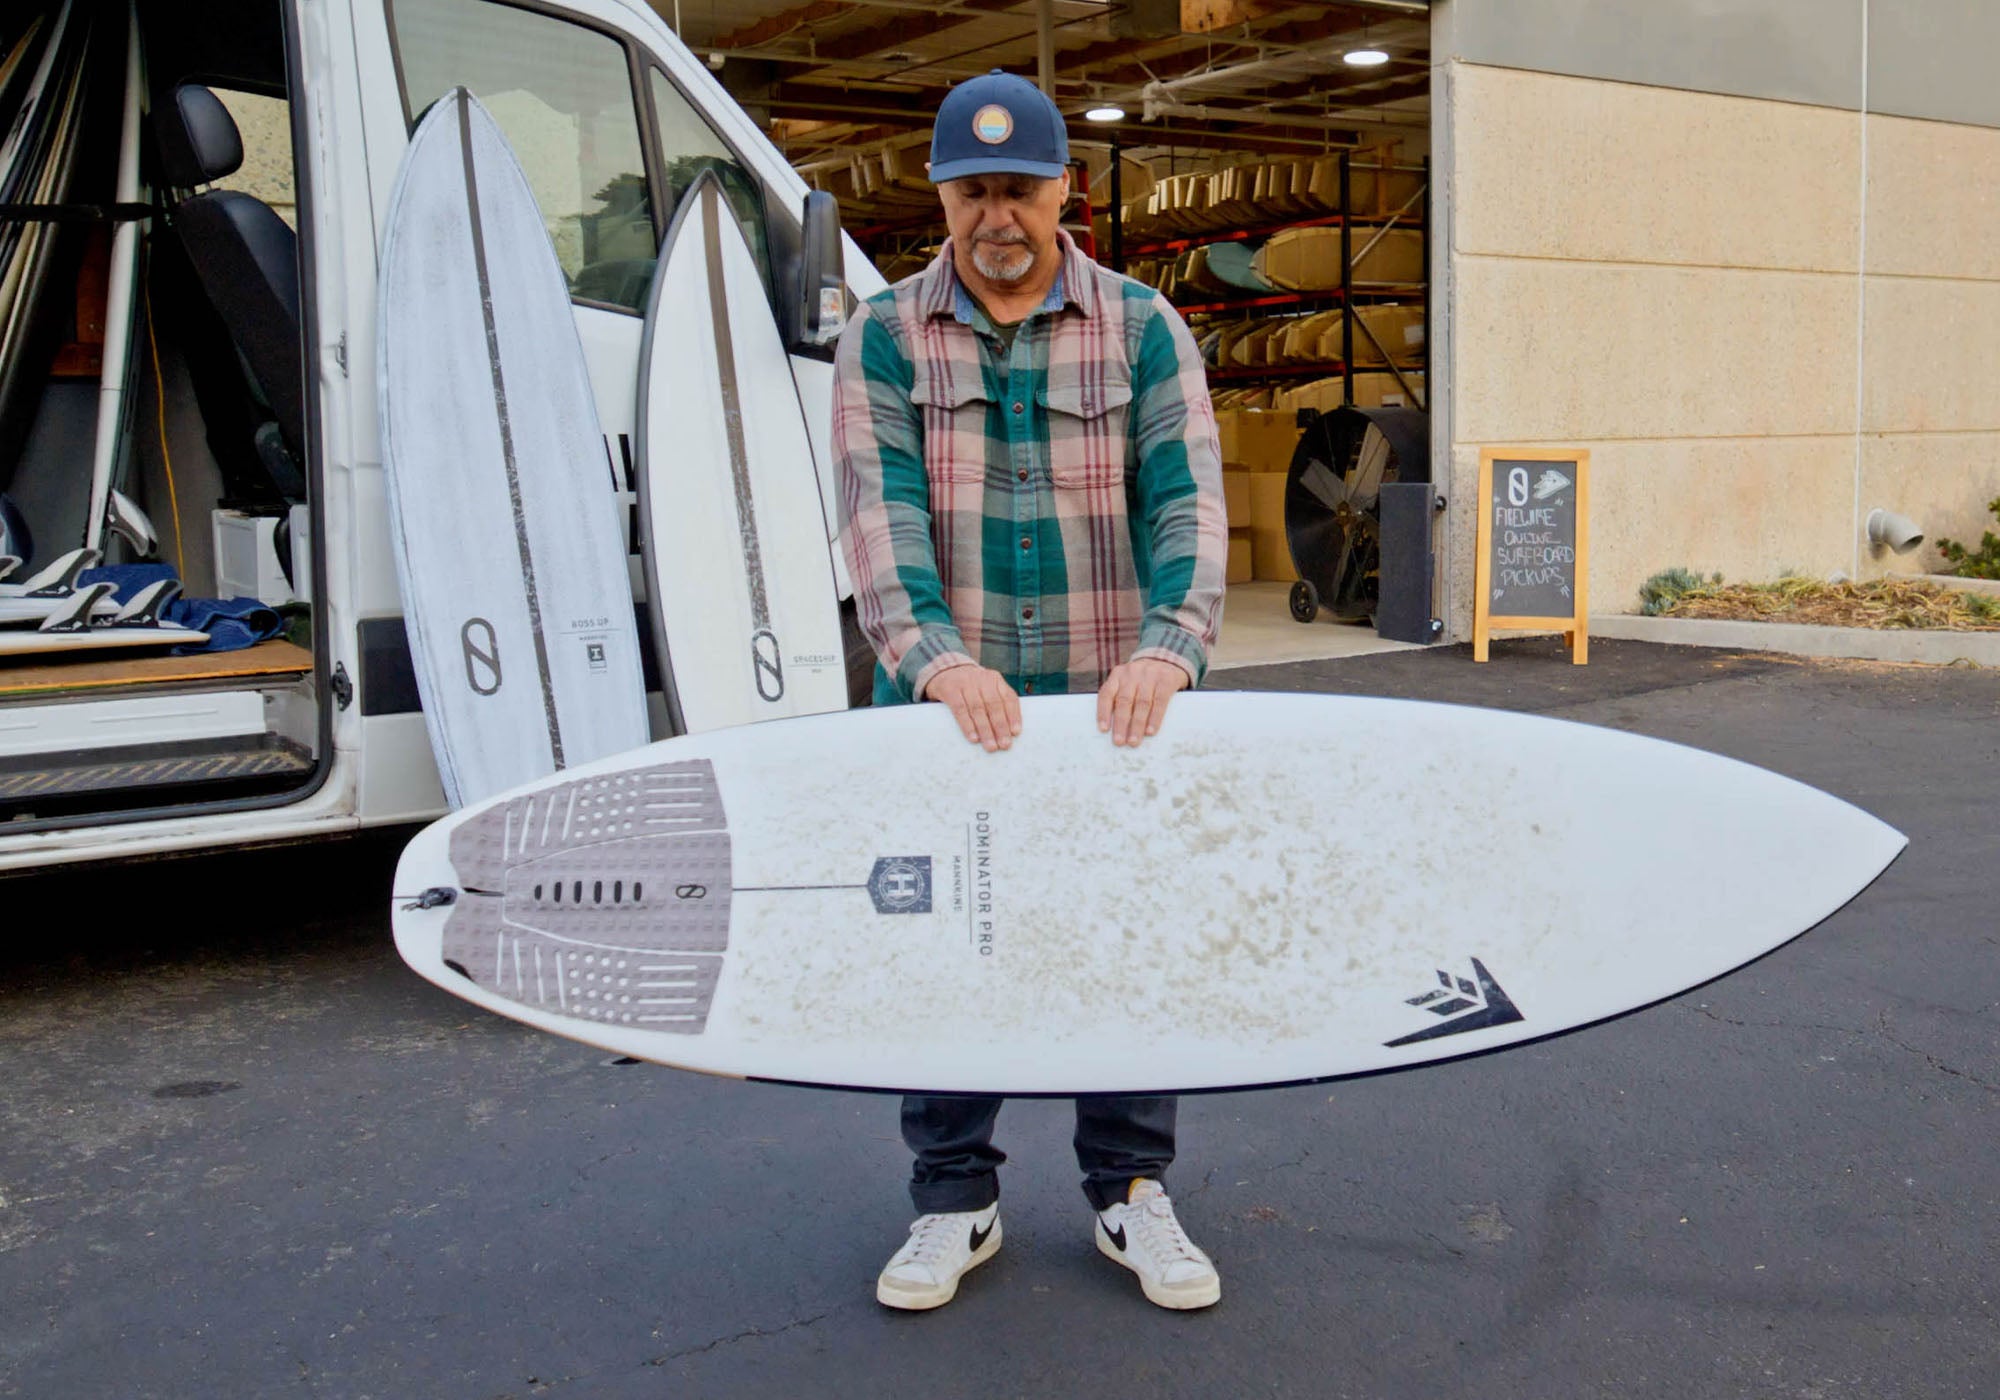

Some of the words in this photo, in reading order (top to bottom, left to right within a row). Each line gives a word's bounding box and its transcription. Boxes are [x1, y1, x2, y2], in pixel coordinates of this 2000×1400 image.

[1504, 530, 1561, 546] ONLINE
[1498, 546, 1575, 567] SURFBOARD
[1501, 566, 1565, 587] PICKUPS
[976, 811, 992, 914] DOMINATOR
[979, 921, 993, 957] PRO
